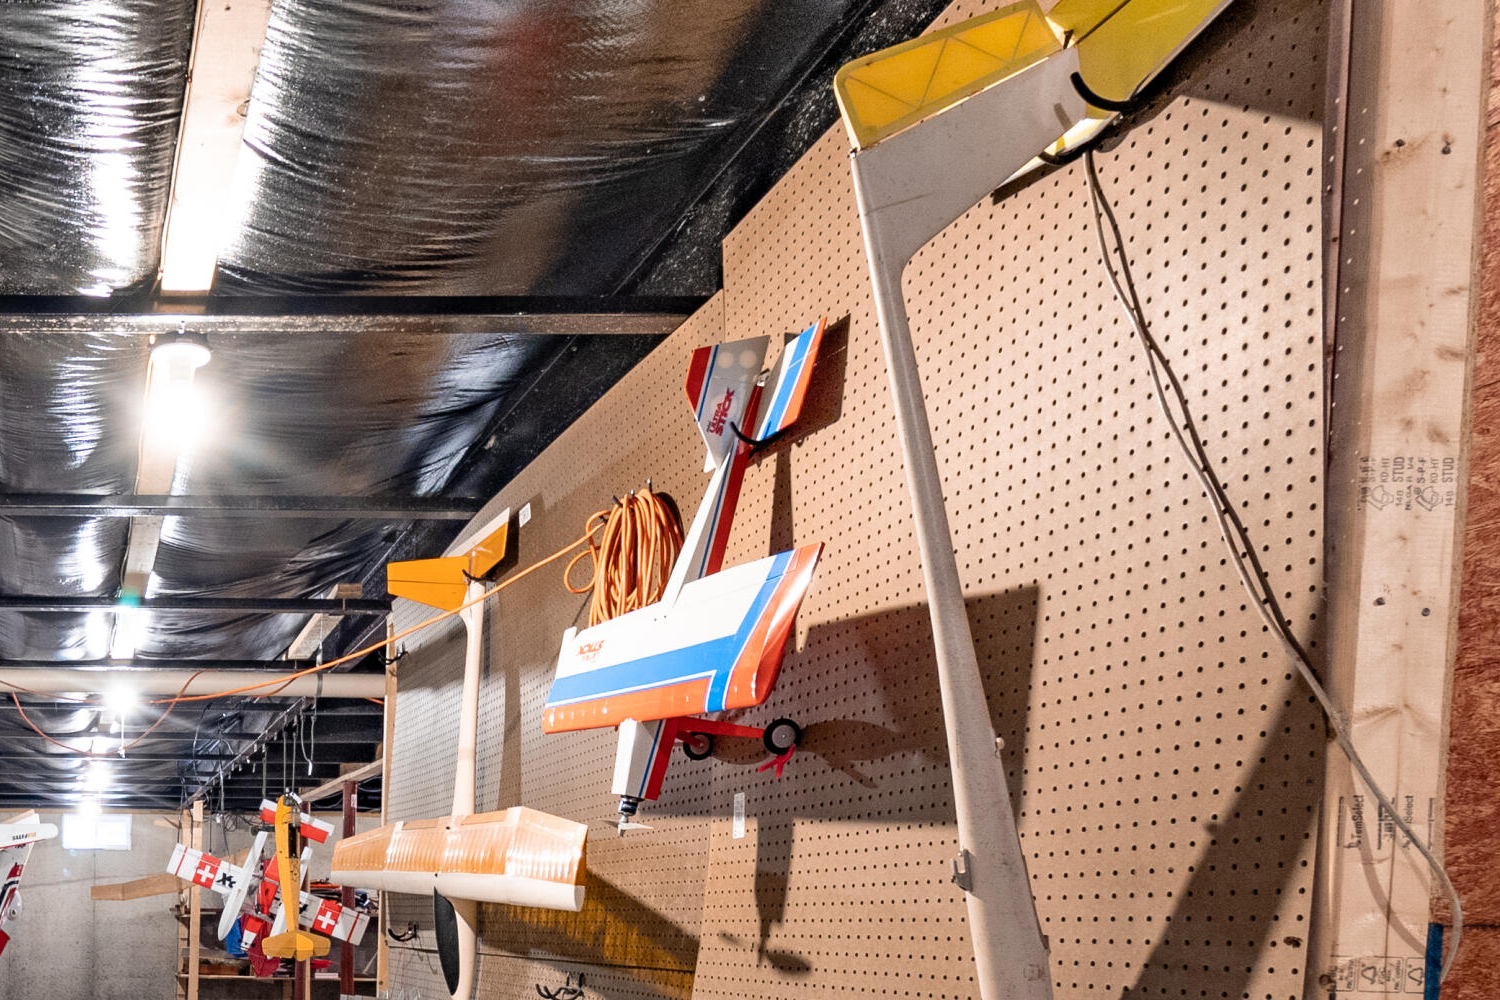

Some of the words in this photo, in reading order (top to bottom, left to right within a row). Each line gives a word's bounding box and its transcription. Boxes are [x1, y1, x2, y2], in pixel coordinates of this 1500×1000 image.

[710, 403, 723, 433] ULTRA
[716, 387, 735, 436] STICK
[1392, 456, 1405, 483] STUD
[1416, 457, 1426, 484] S-P-F
[1442, 457, 1454, 483] STUD
